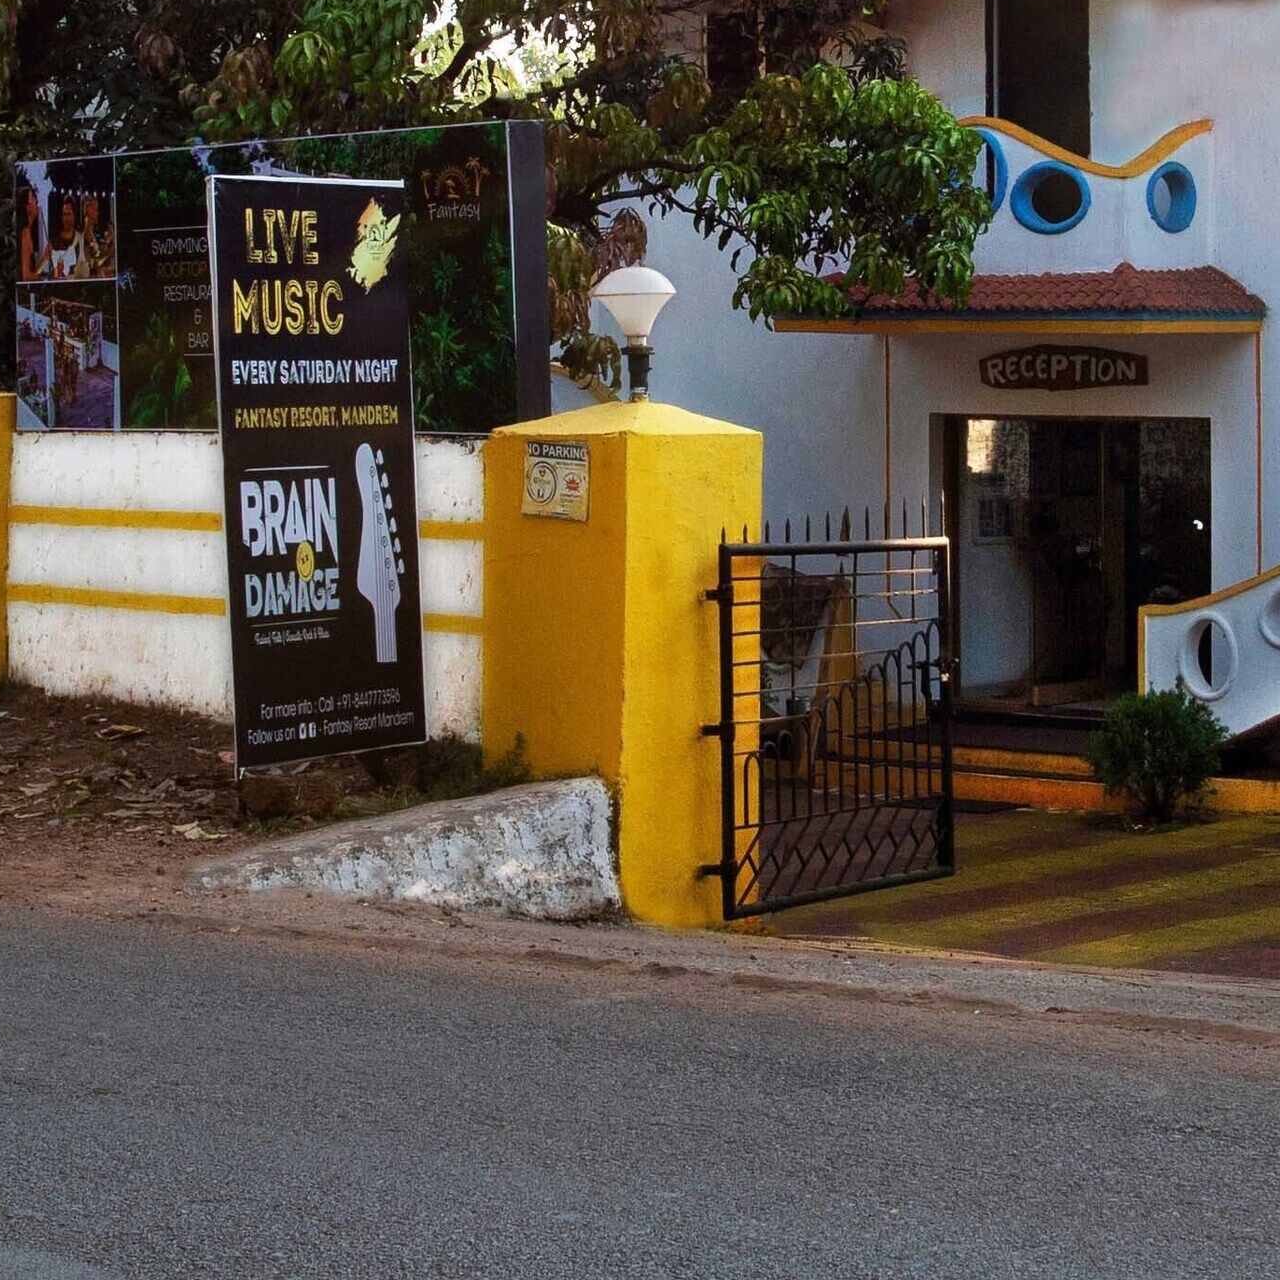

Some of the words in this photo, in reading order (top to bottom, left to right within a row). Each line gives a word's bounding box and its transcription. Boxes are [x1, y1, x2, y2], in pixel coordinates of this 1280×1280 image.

[427, 201, 481, 221] Fantasy
[151, 237, 208, 255] SWIMMING
[244, 207, 318, 265] LIVE
[233, 279, 345, 335] MUSIC
[188, 332, 209, 349] BAR
[232, 360, 276, 385] EVERY
[280, 359, 352, 384] SATURDAY
[355, 358, 398, 383] NIGHT
[986, 354, 1137, 385] RECEPTION
[235, 407, 288, 429] FANTASY
[291, 407, 339, 428] RESORT,
[342, 405, 398, 427] MANDREM
[542, 445, 587, 460] PARKING
[239, 477, 340, 564] BRAIN
[245, 568, 340, 617] DAMAGE
[260, 703, 275, 720] For
[275, 705, 297, 718] more
[297, 699, 313, 715] info
[318, 696, 334, 713] Call
[247, 729, 273, 745] Follow
[274, 730, 284, 742] us
[285, 727, 295, 740] on
[323, 719, 353, 736] Fantasy
[353, 715, 377, 732] Resort
